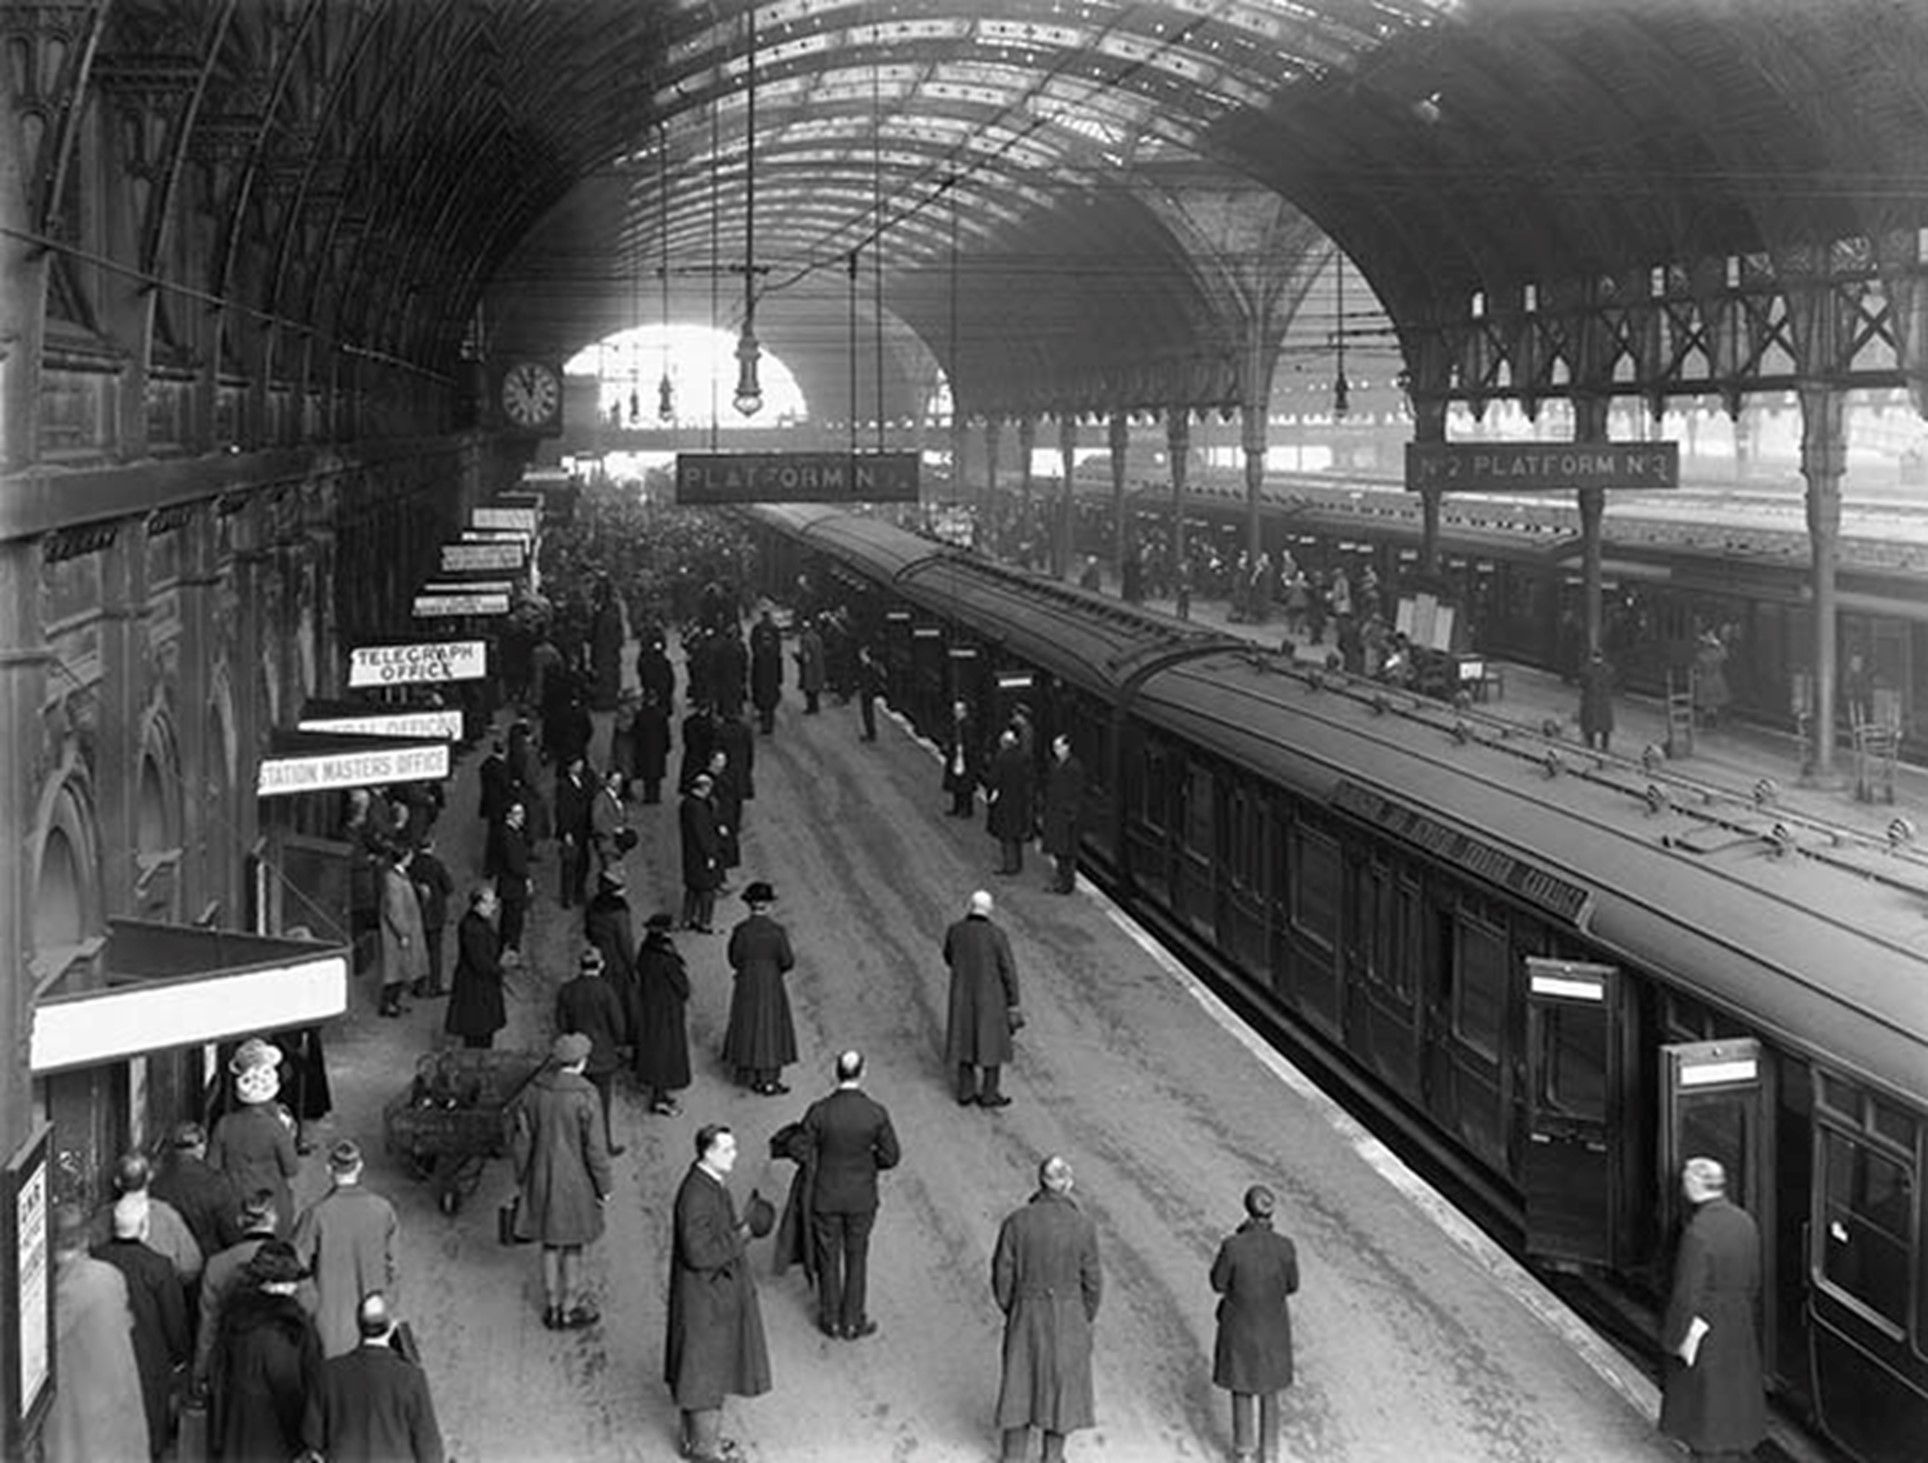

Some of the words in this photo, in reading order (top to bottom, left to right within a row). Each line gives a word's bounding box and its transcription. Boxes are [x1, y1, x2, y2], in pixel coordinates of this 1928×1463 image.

[1473, 454, 1615, 476] PLATFORM
[685, 467, 843, 488] PLATFORM
[359, 645, 472, 666] TELEGRAPH
[381, 661, 452, 680] OFFICE
[322, 756, 391, 782] MASTERS
[396, 750, 445, 776] OFFICE
